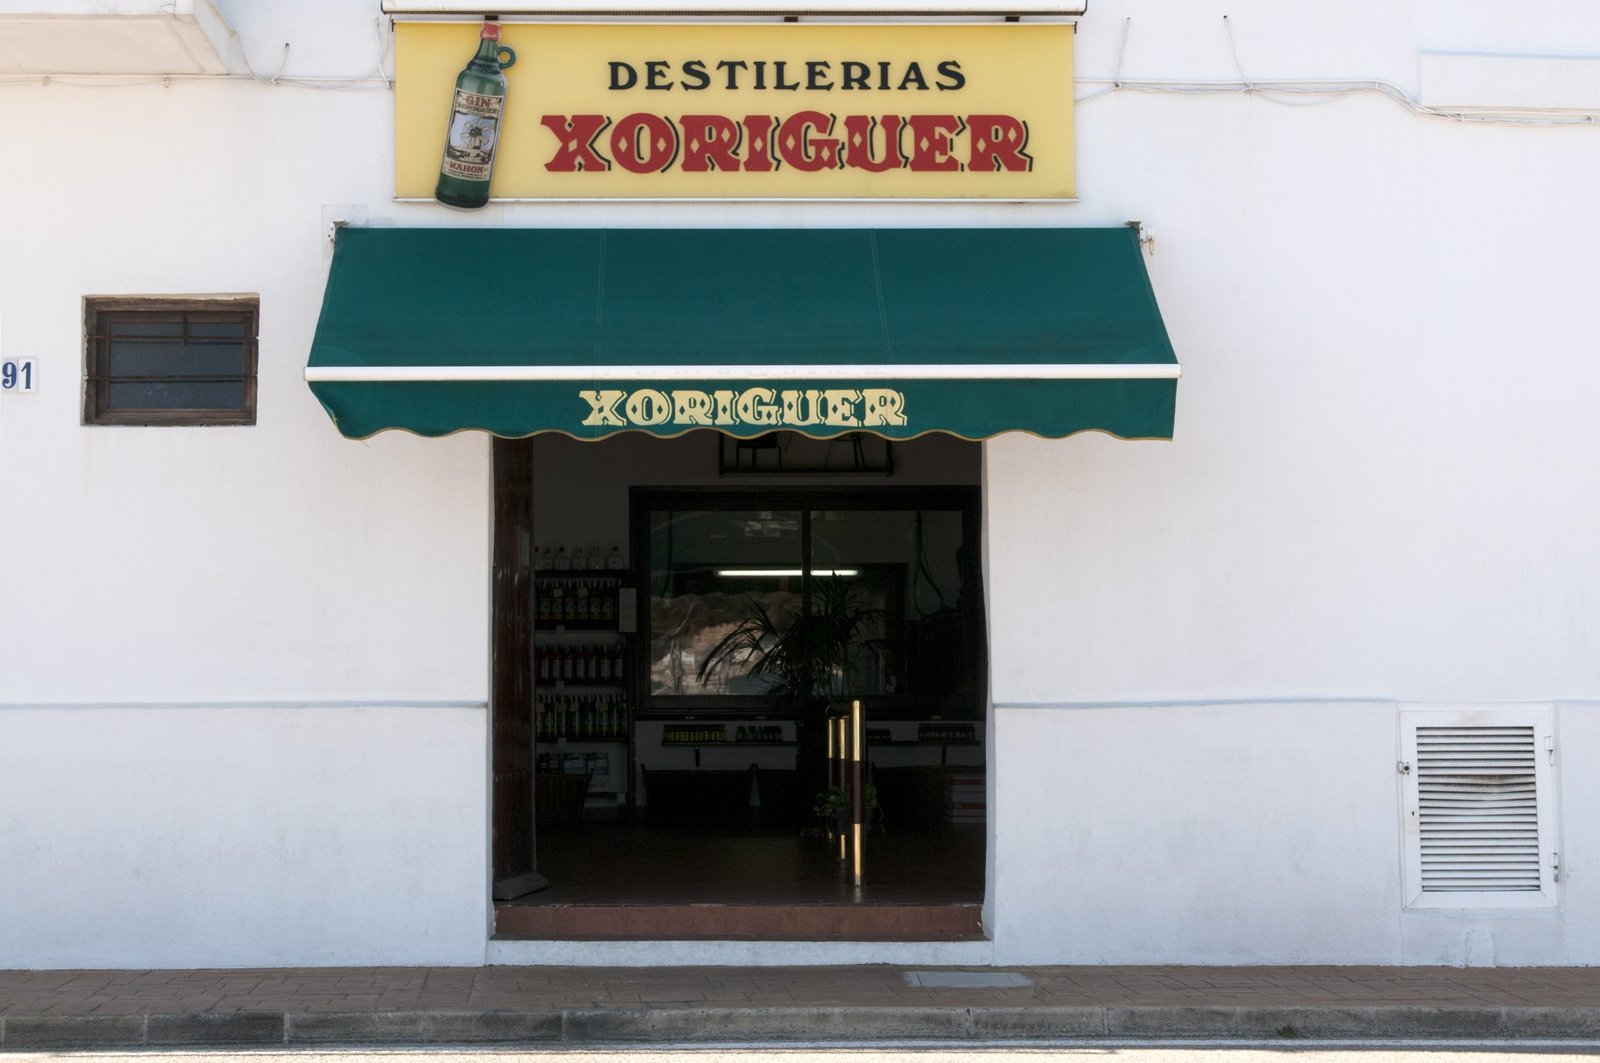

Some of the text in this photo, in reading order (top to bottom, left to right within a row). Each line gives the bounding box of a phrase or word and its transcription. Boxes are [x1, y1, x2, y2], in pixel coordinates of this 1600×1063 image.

[608, 60, 966, 91] DESTILERIAS
[465, 95, 491, 108] GIN
[541, 110, 1033, 174] XORIGUER
[2, 361, 32, 389] 91
[579, 387, 907, 426] XORIGUER
